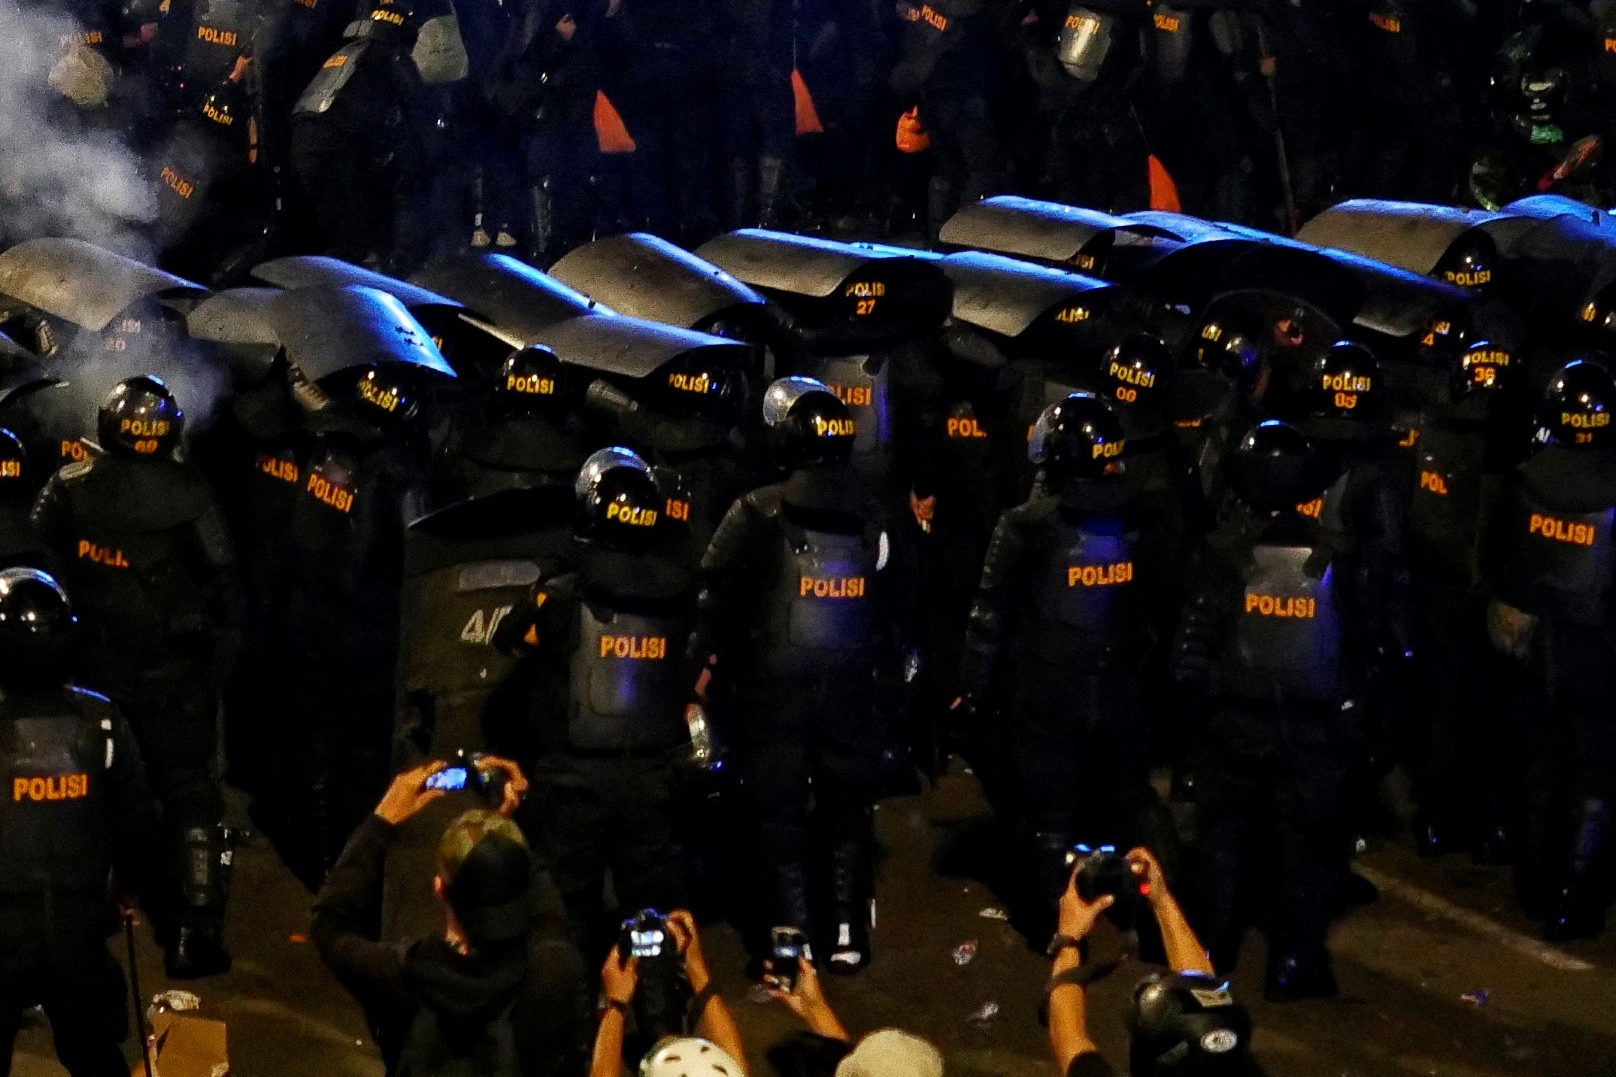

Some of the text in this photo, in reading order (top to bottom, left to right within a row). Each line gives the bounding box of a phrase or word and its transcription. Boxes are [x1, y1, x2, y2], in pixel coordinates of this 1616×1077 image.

[371, 9, 404, 25] POLISI
[922, 3, 947, 31] POLISI
[197, 26, 236, 46] POLISI
[204, 104, 233, 126] POLISI
[160, 166, 193, 199] POLISI
[1446, 270, 1491, 288] POLISI
[857, 300, 876, 315] 27
[506, 375, 554, 394] POLISI
[668, 374, 709, 393] POLISI
[1110, 363, 1155, 388] POLISI
[1323, 375, 1370, 391] POLISI
[121, 419, 170, 437] POLISI
[1562, 412, 1610, 428] POLISI
[306, 472, 354, 513] POLISI
[607, 503, 658, 526] POLISI
[1529, 513, 1595, 545] POLISI
[1068, 563, 1133, 586] POLISI
[800, 577, 866, 598] POLISI
[1245, 593, 1315, 617] POLISI
[601, 636, 666, 659] POLISI
[13, 773, 89, 801] POLISI
